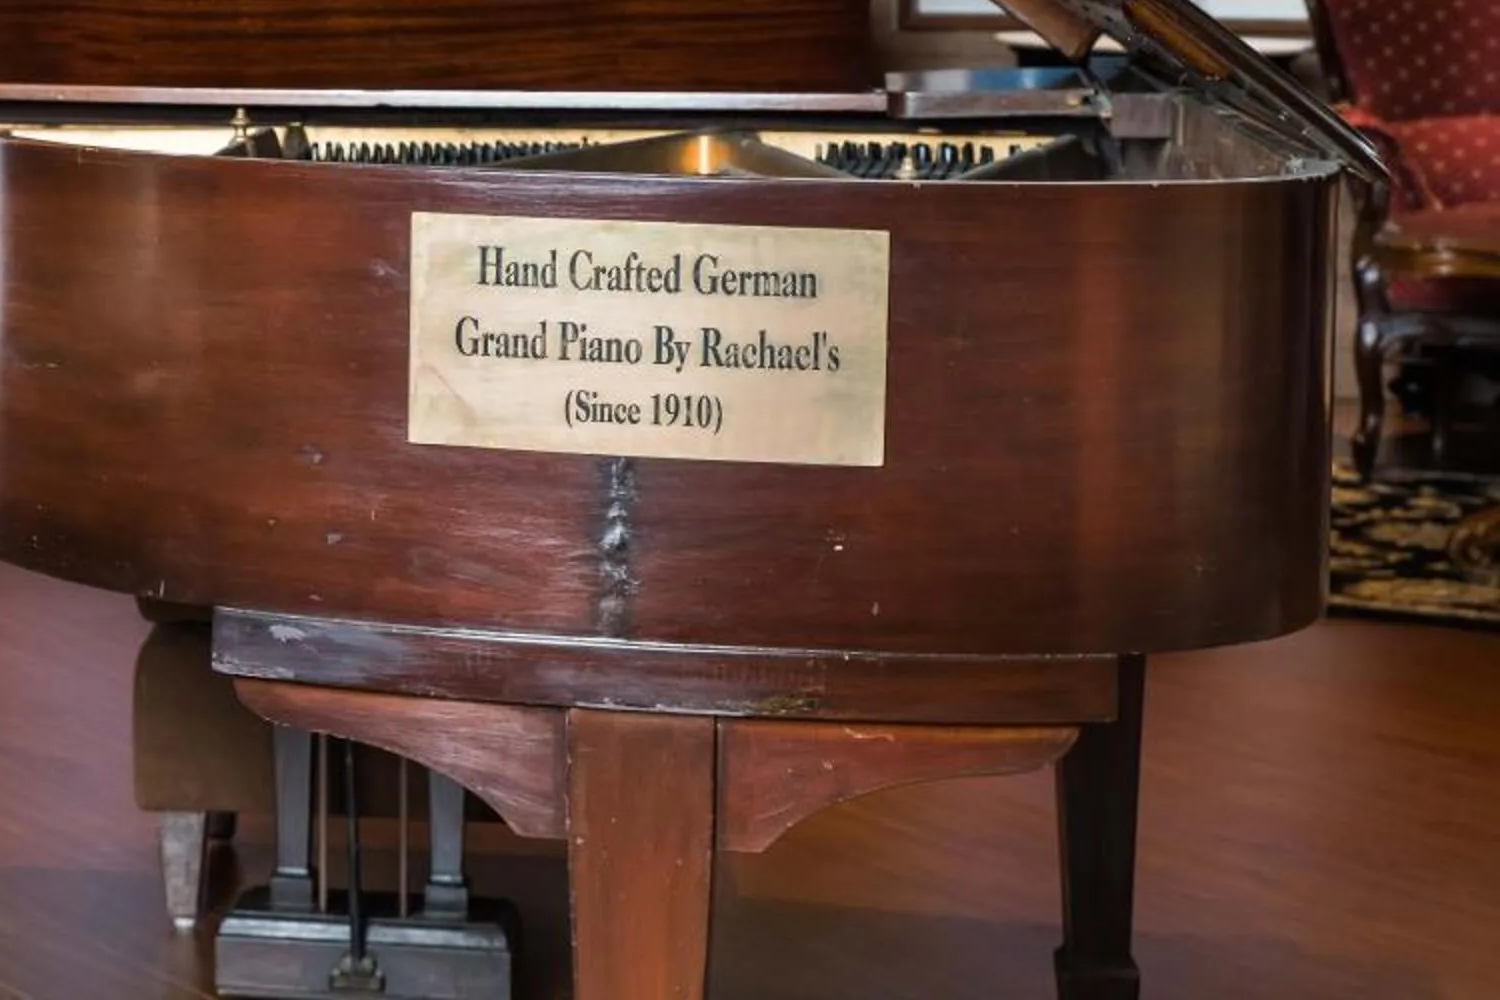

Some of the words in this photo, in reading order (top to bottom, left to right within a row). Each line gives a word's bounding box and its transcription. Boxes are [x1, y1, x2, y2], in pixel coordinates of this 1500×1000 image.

[477, 246, 557, 289] Hand
[569, 250, 681, 295] Crafted
[693, 253, 818, 298] German
[454, 315, 547, 360] Grand
[557, 321, 643, 365] Piano
[652, 324, 691, 373] By
[699, 327, 840, 372] Rachael's
[564, 389, 641, 428] (Since
[650, 393, 724, 435] 1910)
